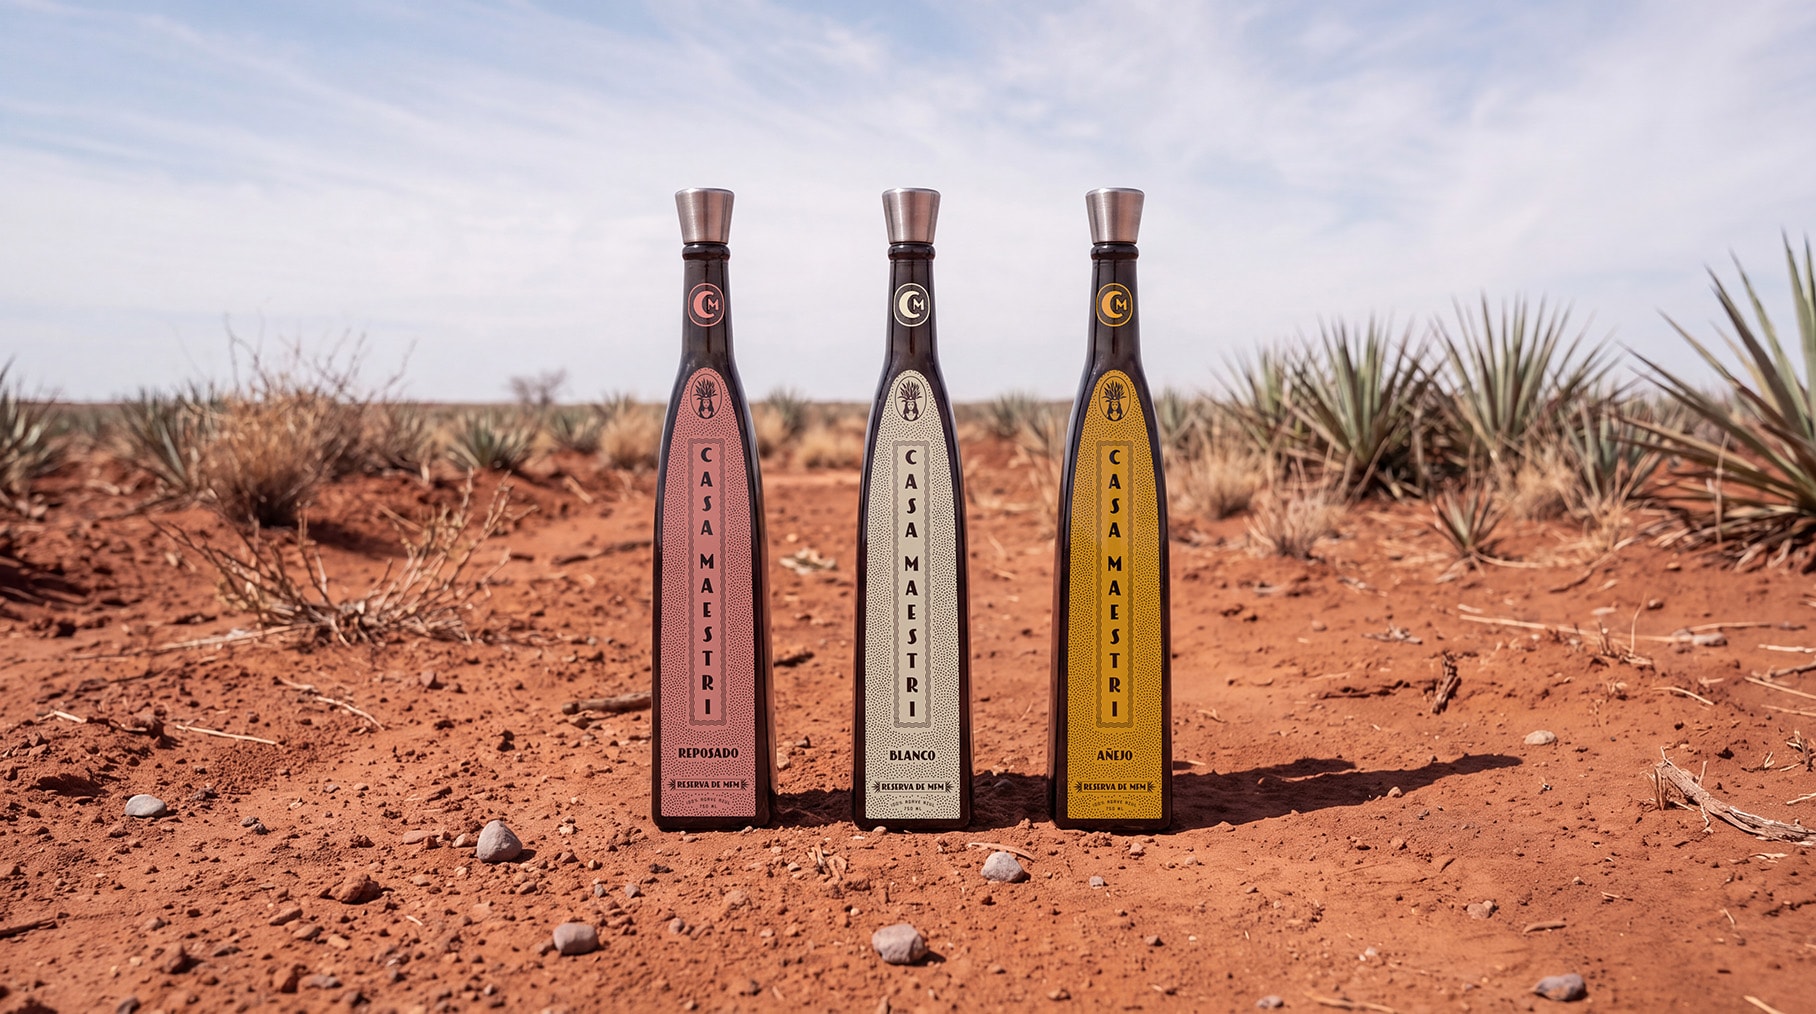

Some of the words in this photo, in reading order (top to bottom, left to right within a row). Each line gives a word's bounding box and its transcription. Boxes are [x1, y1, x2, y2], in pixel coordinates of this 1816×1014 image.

[700, 447, 713, 536] CASA
[904, 450, 918, 538] CASA
[1108, 450, 1121, 538] CASA
[700, 554, 714, 714] MAESTRI
[904, 556, 918, 717] MAESTRI
[1108, 556, 1122, 717] MAESTRI
[678, 748, 738, 758] REPOSADO
[890, 750, 936, 760] BLANCO
[1096, 748, 1133, 760] AÑEJO
